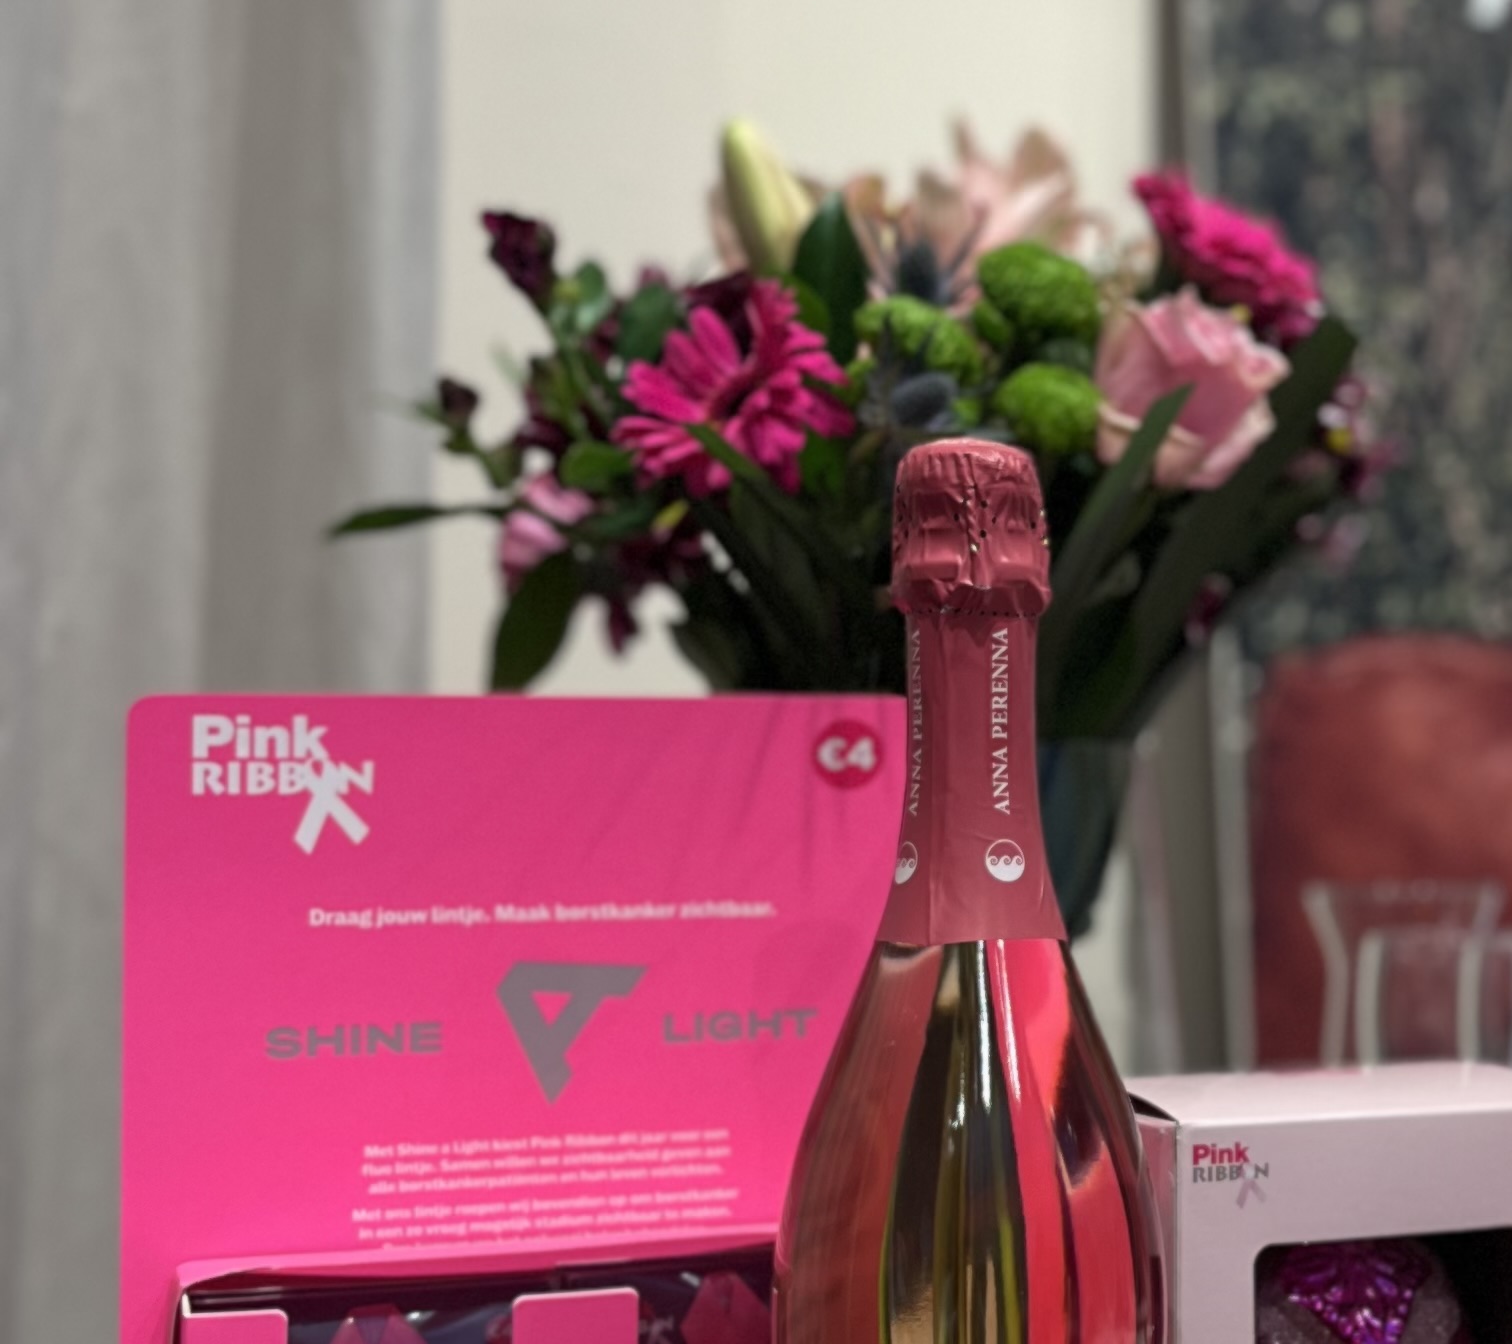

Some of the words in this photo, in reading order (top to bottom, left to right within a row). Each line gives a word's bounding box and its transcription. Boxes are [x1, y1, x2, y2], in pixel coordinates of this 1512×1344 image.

[909, 629, 922, 741] PERENNA
[992, 627, 1009, 739] PERENNA
[192, 714, 329, 759] Pink
[908, 748, 922, 816] ANNA
[993, 747, 1011, 815] ANNA
[309, 908, 372, 929] Draag
[375, 906, 428, 928] jouw
[494, 903, 550, 924] Maak
[265, 1022, 443, 1058] SHINE
[663, 1008, 819, 1045] LIGHT
[1193, 1142, 1249, 1165] Pink
